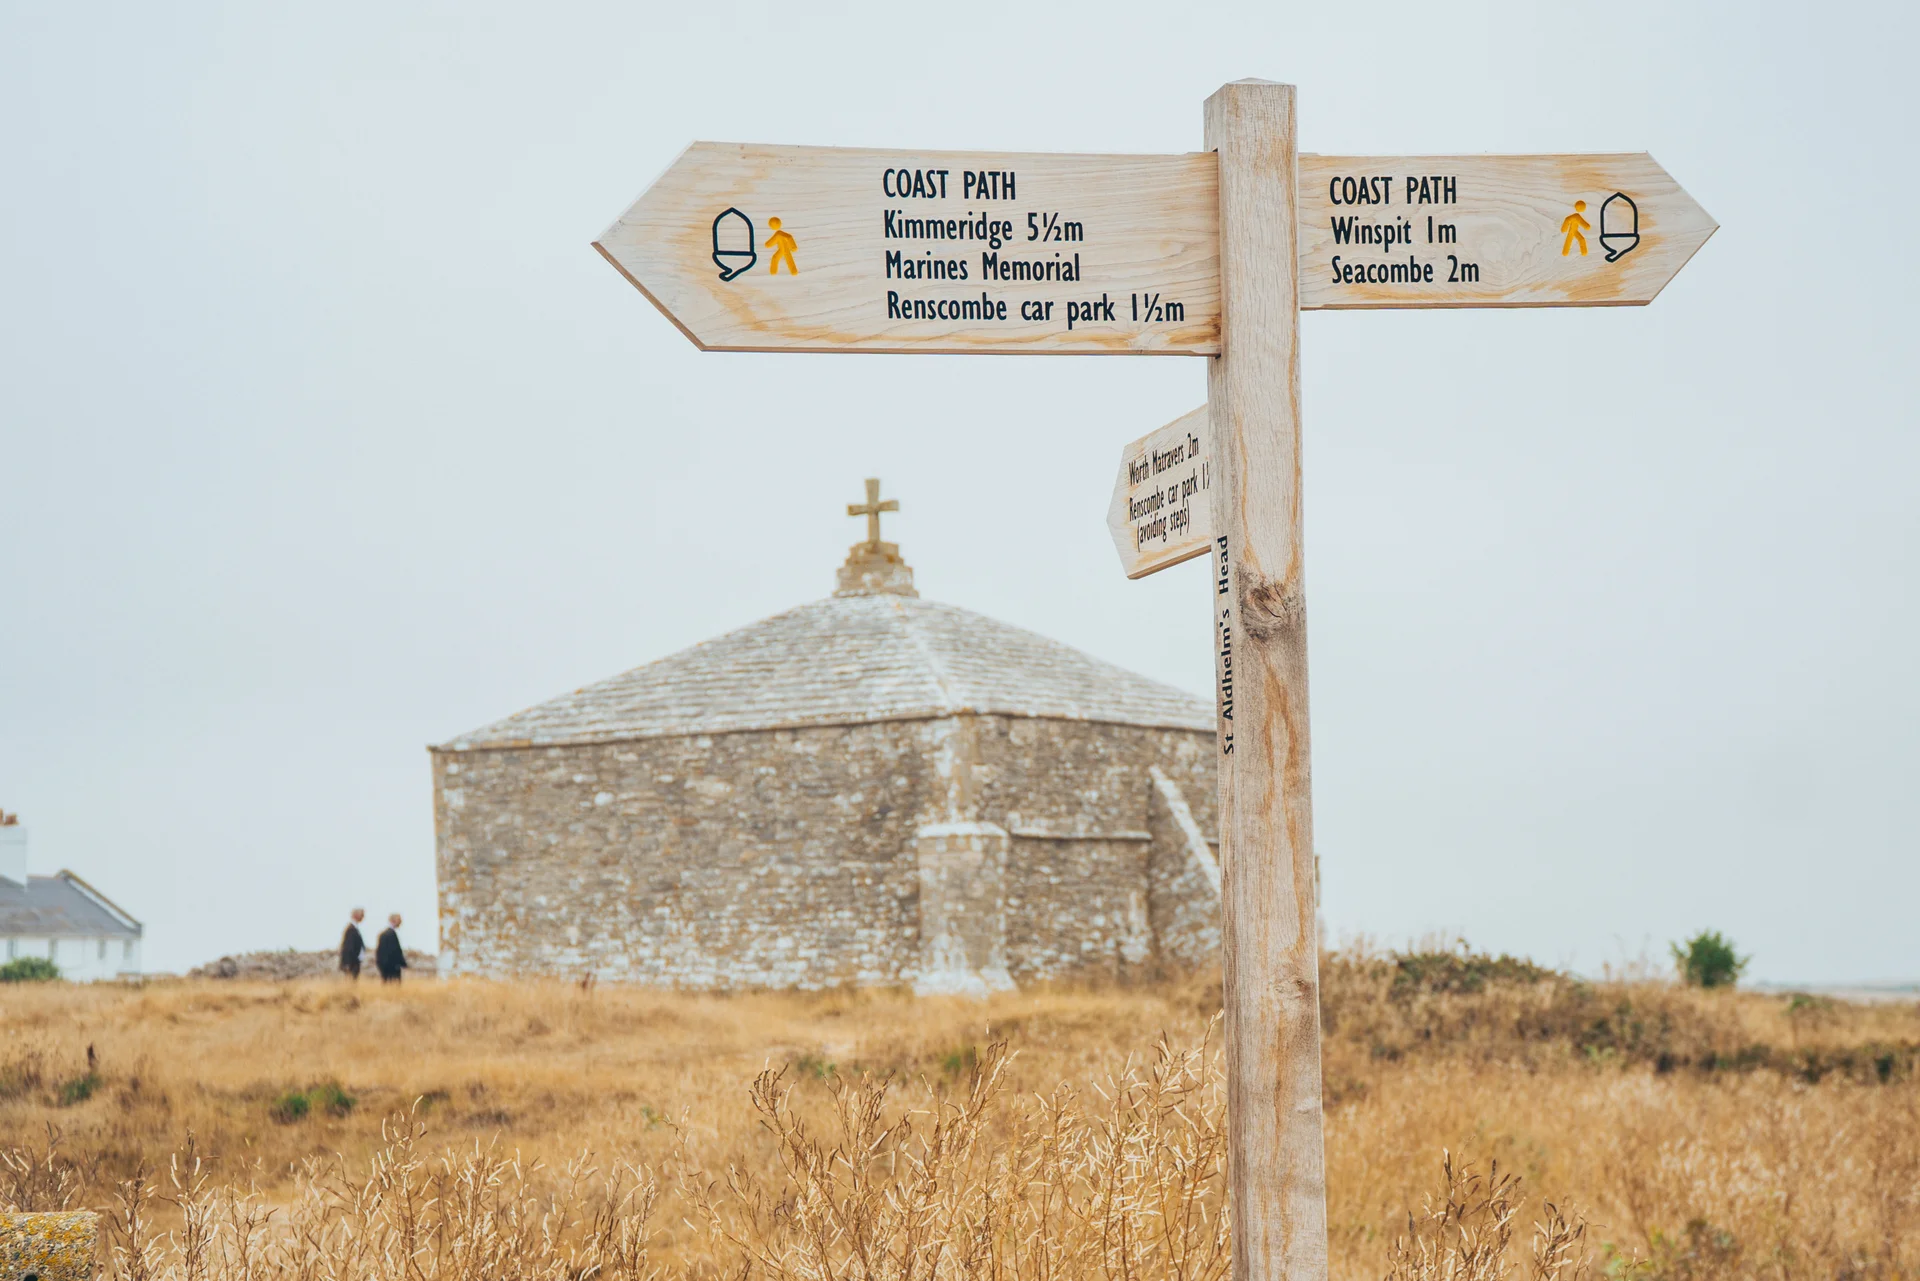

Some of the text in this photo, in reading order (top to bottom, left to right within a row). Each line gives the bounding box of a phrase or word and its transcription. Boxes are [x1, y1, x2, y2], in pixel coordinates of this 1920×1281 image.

[882, 168, 1016, 200] COAST PATH
[1329, 176, 1457, 206] COAST PATH
[884, 209, 1084, 250] Kimmeridge 5½m
[1330, 215, 1457, 253] Winspit 1m
[885, 250, 1080, 282] Marines Memorial
[1331, 254, 1480, 284] Seacombe 2m
[887, 290, 1007, 321] Renscombe
[1020, 300, 1054, 321] car
[1067, 293, 1116, 331] park
[1128, 433, 1199, 486] Worth Matravers 2m
[1129, 485, 1165, 522] Renscombe
[1168, 482, 1178, 504] car
[1182, 468, 1198, 506] park
[1137, 499, 1191, 552] (avoiding steps)
[1217, 535, 1234, 755] St Aldhelm's Head
